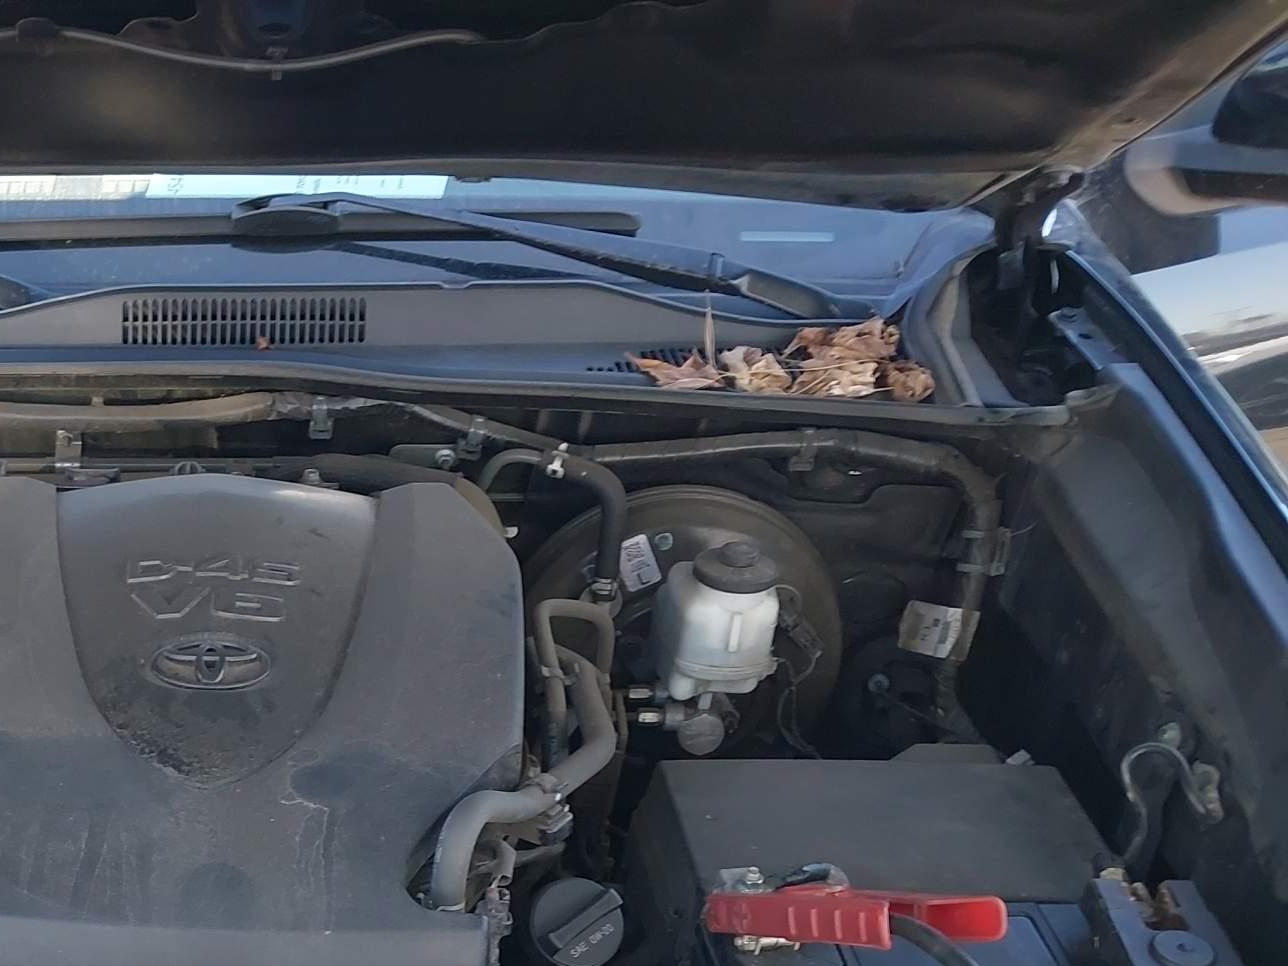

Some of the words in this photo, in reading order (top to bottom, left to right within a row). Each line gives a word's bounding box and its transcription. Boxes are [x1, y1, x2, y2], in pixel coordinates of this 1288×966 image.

[126, 554, 302, 587] D-4S
[130, 586, 288, 622] V6
[569, 940, 590, 958] SAE
